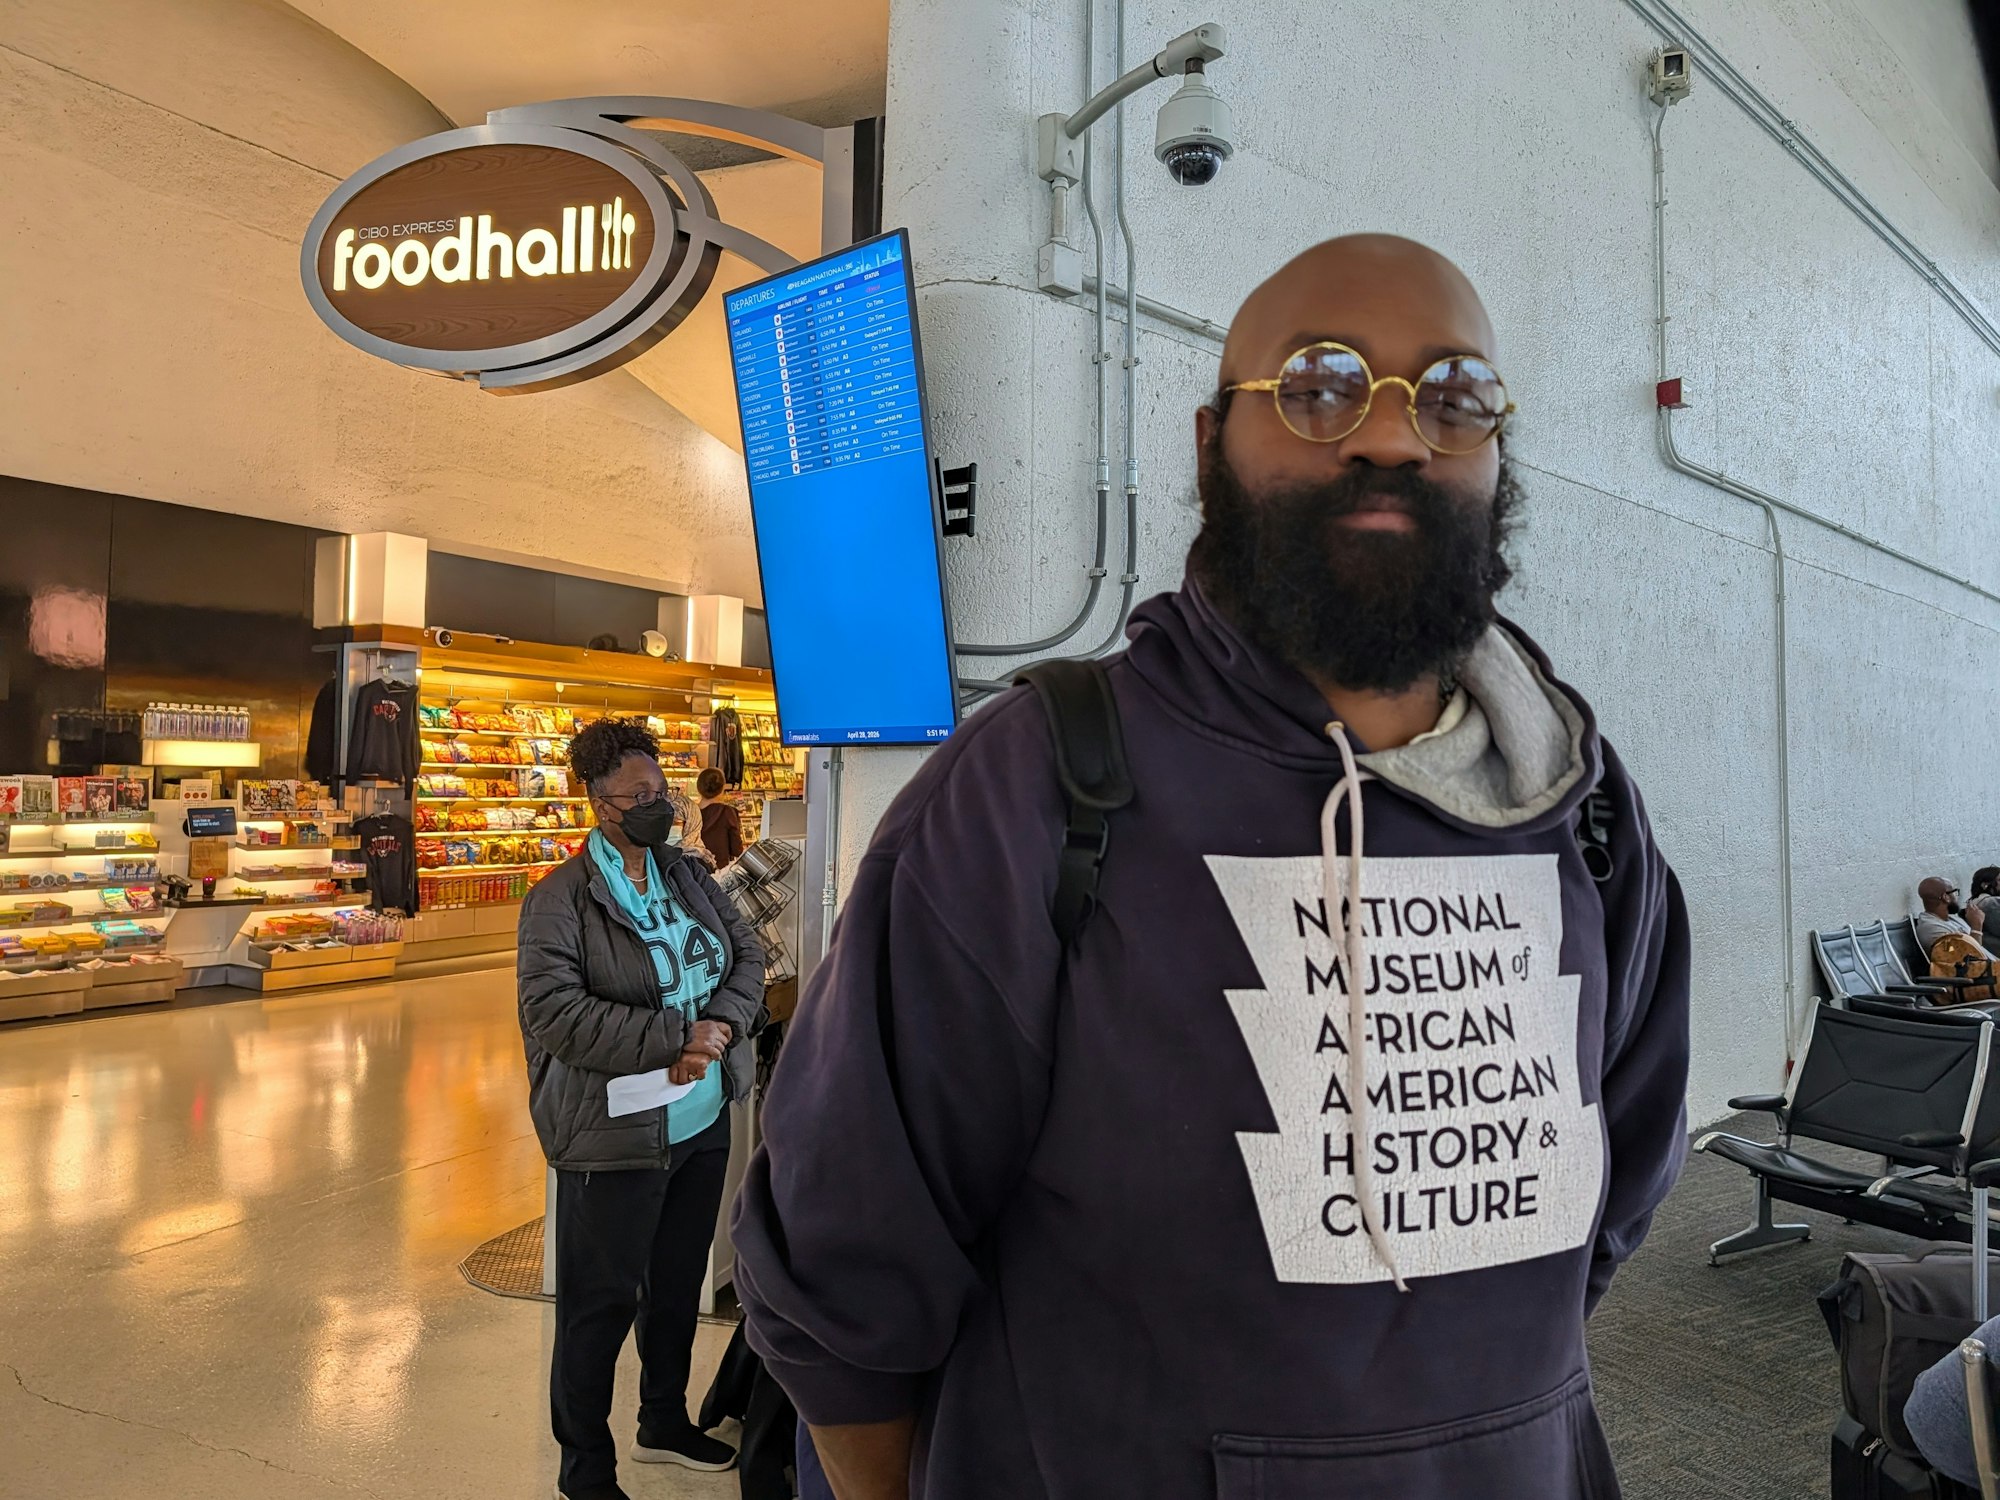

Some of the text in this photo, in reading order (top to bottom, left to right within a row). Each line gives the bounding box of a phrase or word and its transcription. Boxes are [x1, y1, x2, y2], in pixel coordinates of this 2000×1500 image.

[359, 219, 455, 239] CIBO EXPRESS
[333, 205, 595, 291] foodhall
[730, 288, 775, 311] DEPARTURES
[777, 301, 791, 310] AIRLINE
[794, 296, 807, 304] FLIGHT
[864, 271, 879, 280] STATUS
[875, 312, 885, 320] Time
[871, 388, 884, 396] Delayed
[847, 731, 859, 739] April
[1512, 946, 1531, 981] of
[1315, 1002, 1516, 1054] ARICAN
[1320, 1054, 1560, 1114] AMERICAN
[1323, 1117, 1558, 1175] HSTORY &
